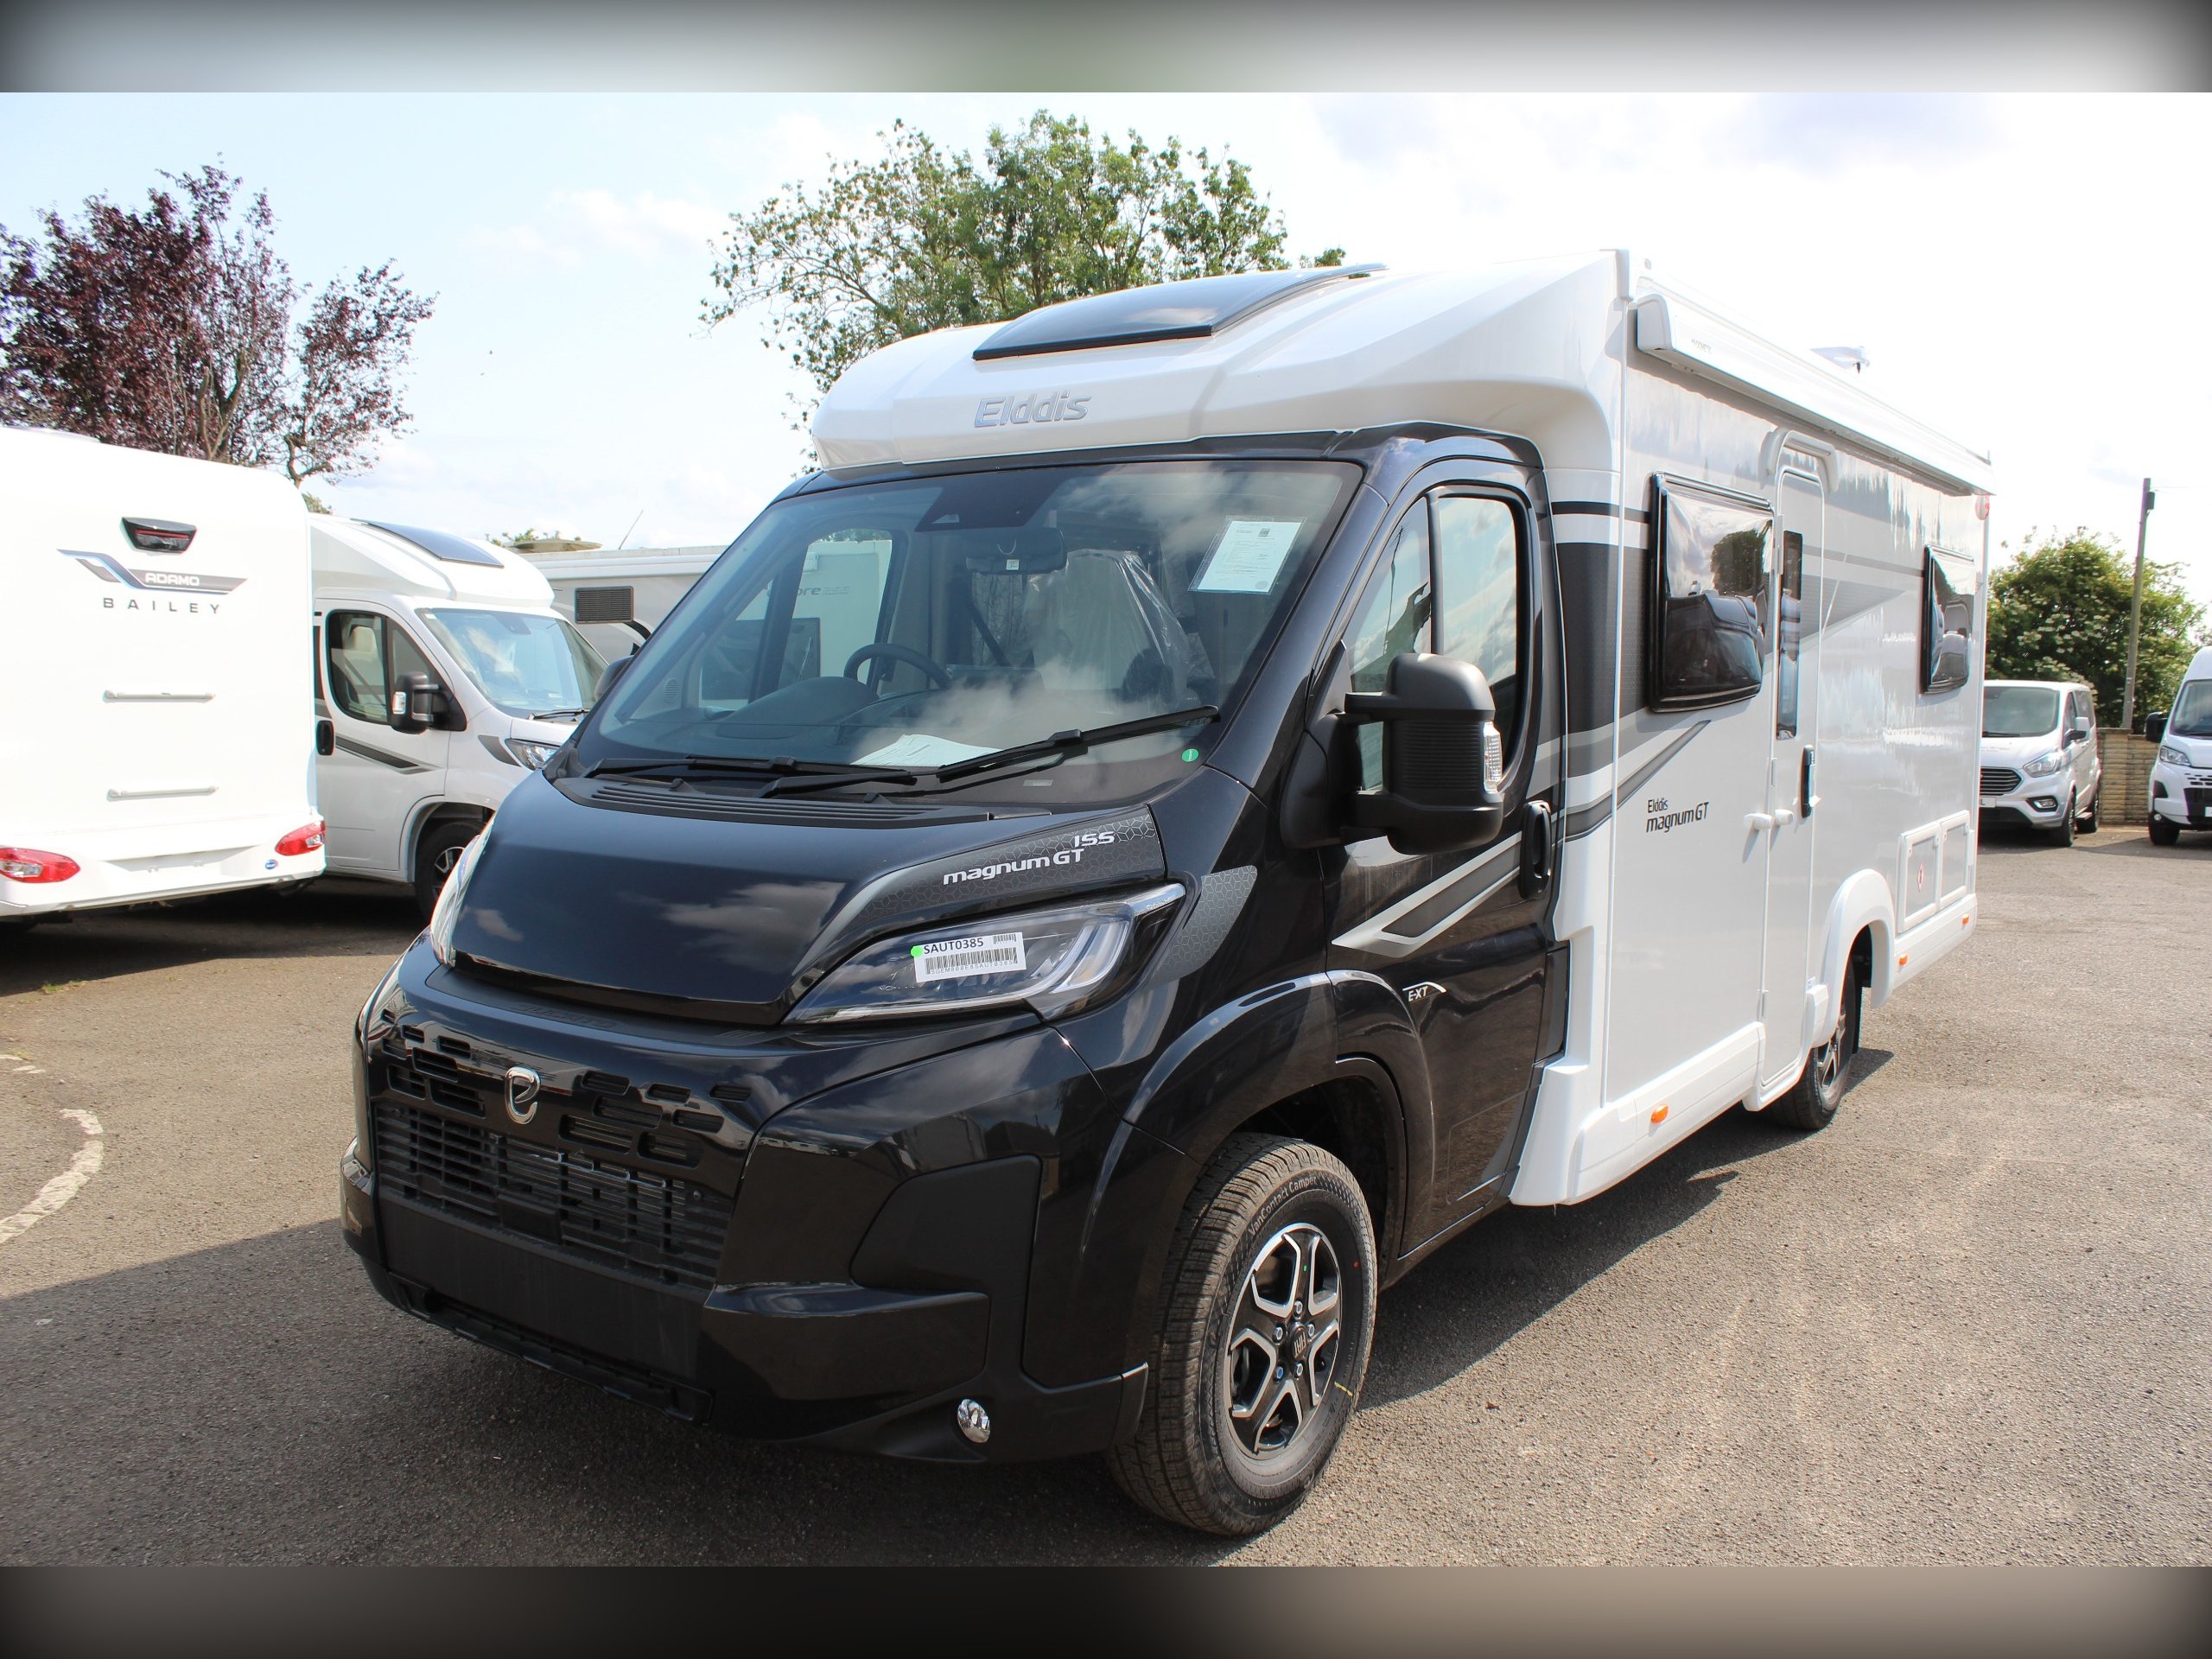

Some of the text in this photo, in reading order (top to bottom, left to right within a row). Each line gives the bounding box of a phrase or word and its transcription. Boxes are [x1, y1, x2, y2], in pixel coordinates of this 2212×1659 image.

[974, 390, 1092, 428] Elddis
[144, 572, 200, 586] ADAMO
[103, 597, 219, 613] BAILEY
[1648, 798, 1669, 813] Elddis
[1646, 802, 1709, 833] magnum GT
[943, 848, 1084, 886] magnum GT
[924, 938, 984, 955] SAUT0385
[1289, 1175, 1317, 1193] Camper
